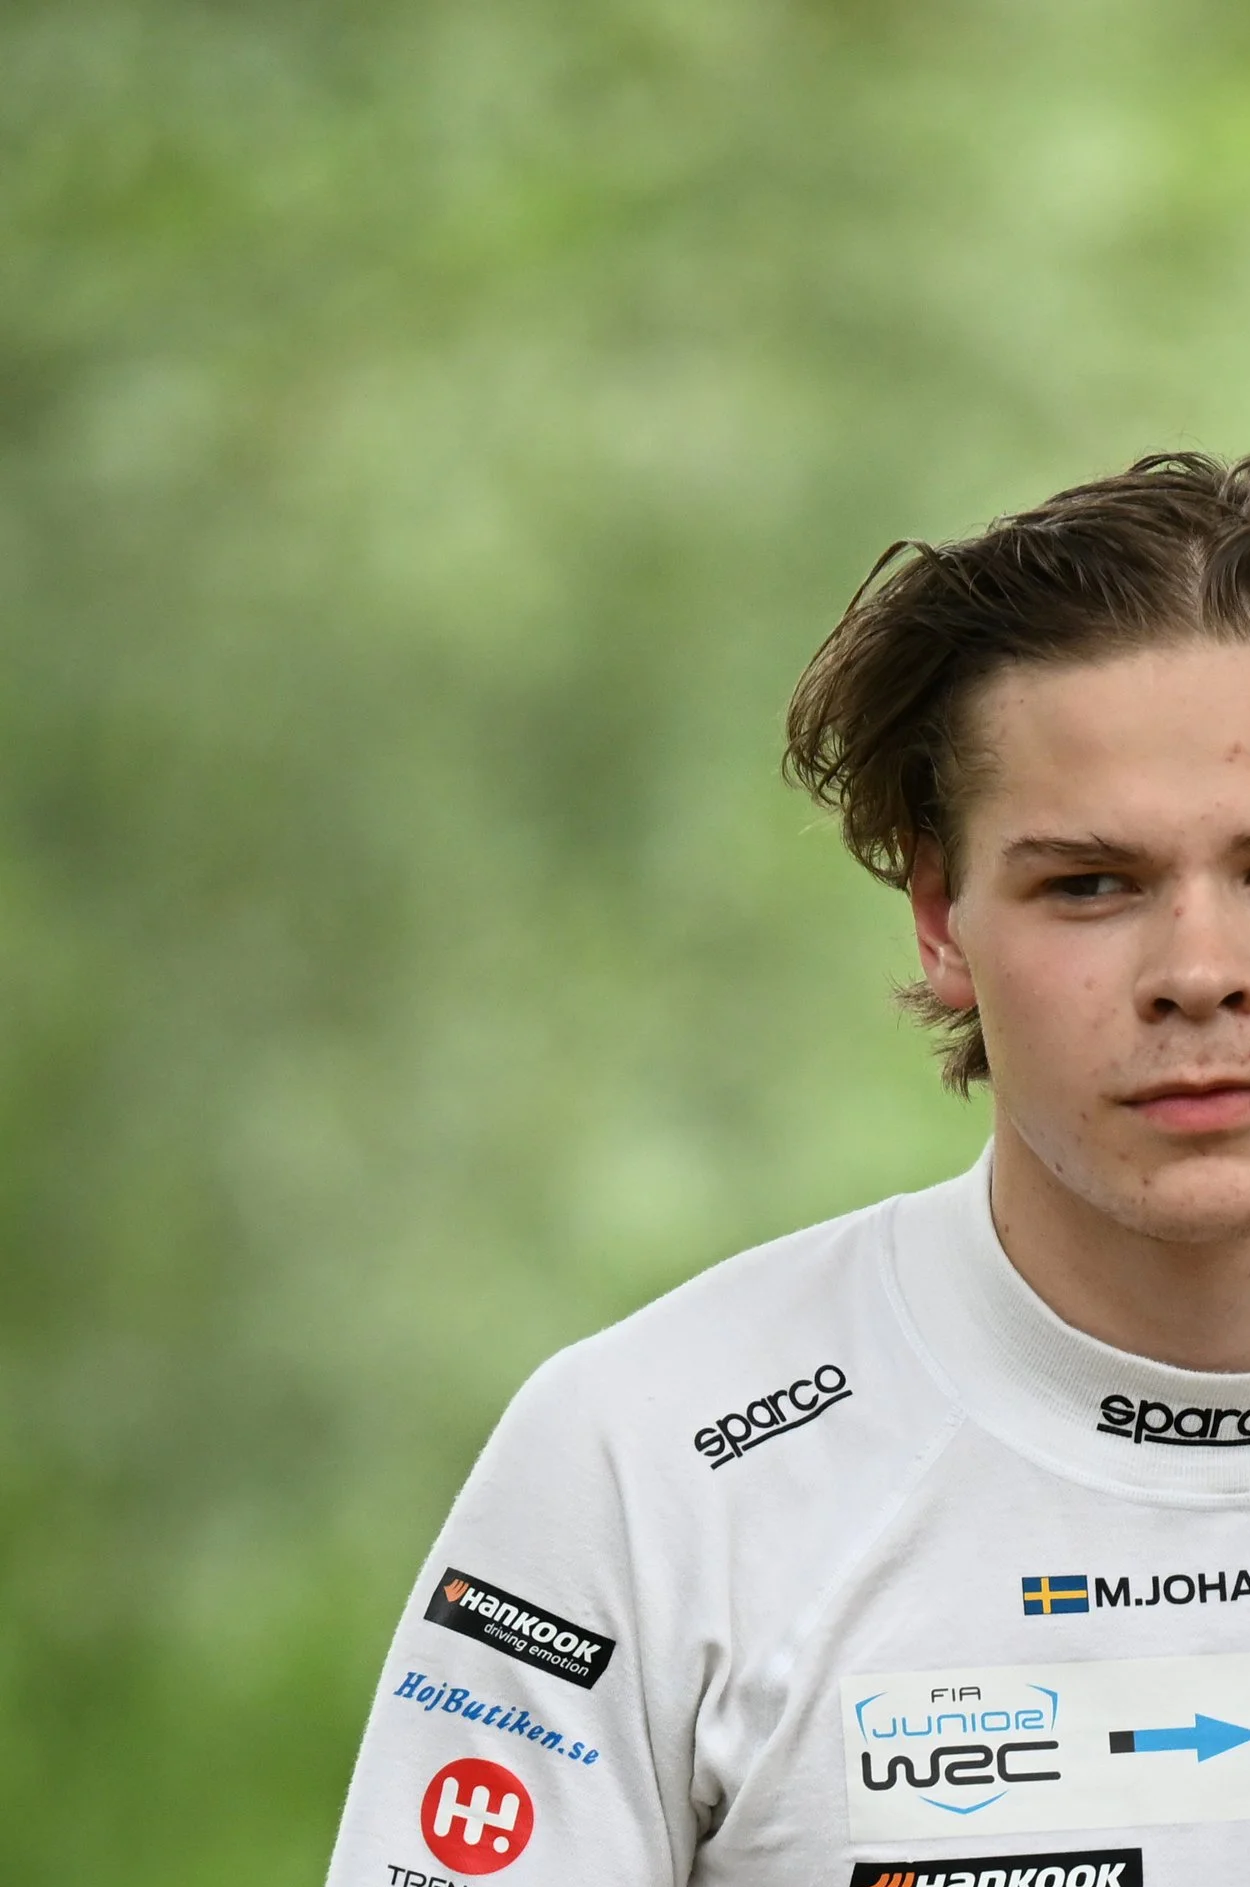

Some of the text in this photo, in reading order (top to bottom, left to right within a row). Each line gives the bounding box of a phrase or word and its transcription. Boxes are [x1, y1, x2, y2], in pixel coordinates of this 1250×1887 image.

[694, 1364, 849, 1464] sparco
[484, 1620, 589, 1677] driving emotion
[931, 1685, 981, 1704] FIA
[872, 1710, 1044, 1739] JUNIOR
[861, 1740, 1061, 1791] WRC
